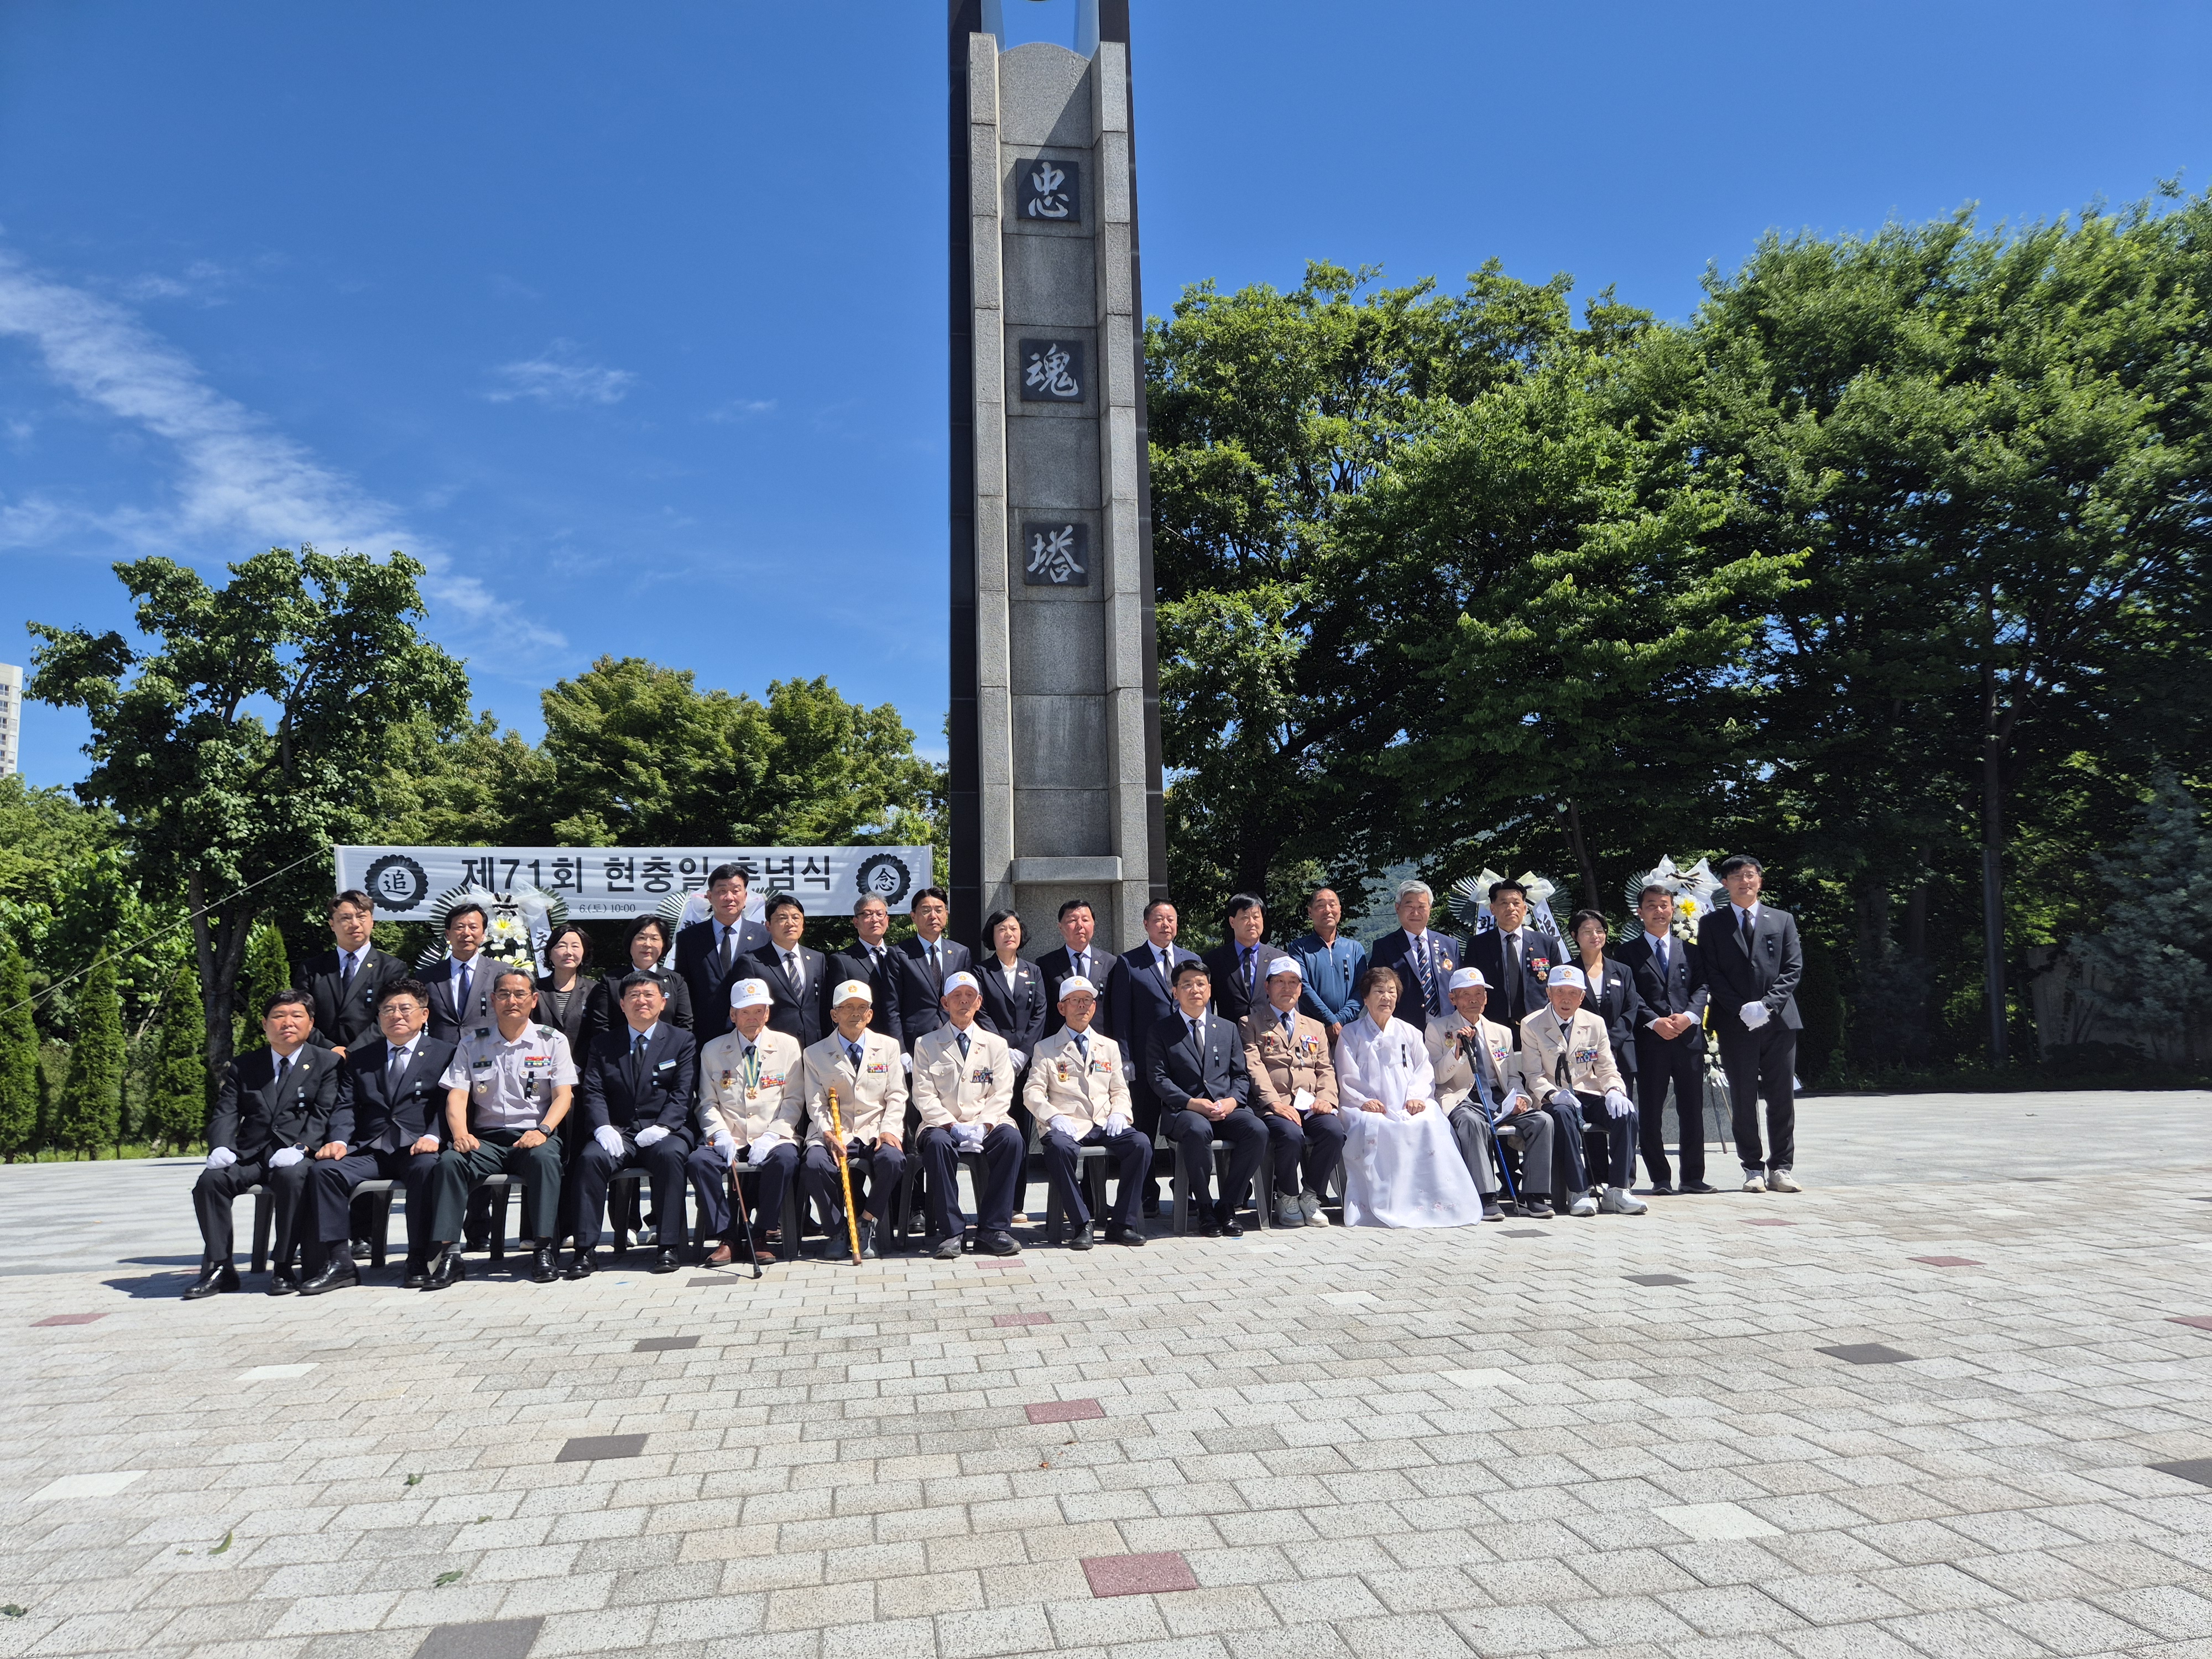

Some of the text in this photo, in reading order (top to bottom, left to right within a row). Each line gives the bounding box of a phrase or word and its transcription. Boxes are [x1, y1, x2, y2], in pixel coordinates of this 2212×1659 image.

[383, 869, 411, 895] 追
[460, 856, 582, 893] 제71회
[603, 856, 708, 893] 현충일
[874, 868, 896, 891] 念
[611, 904, 636, 912] 10:00
